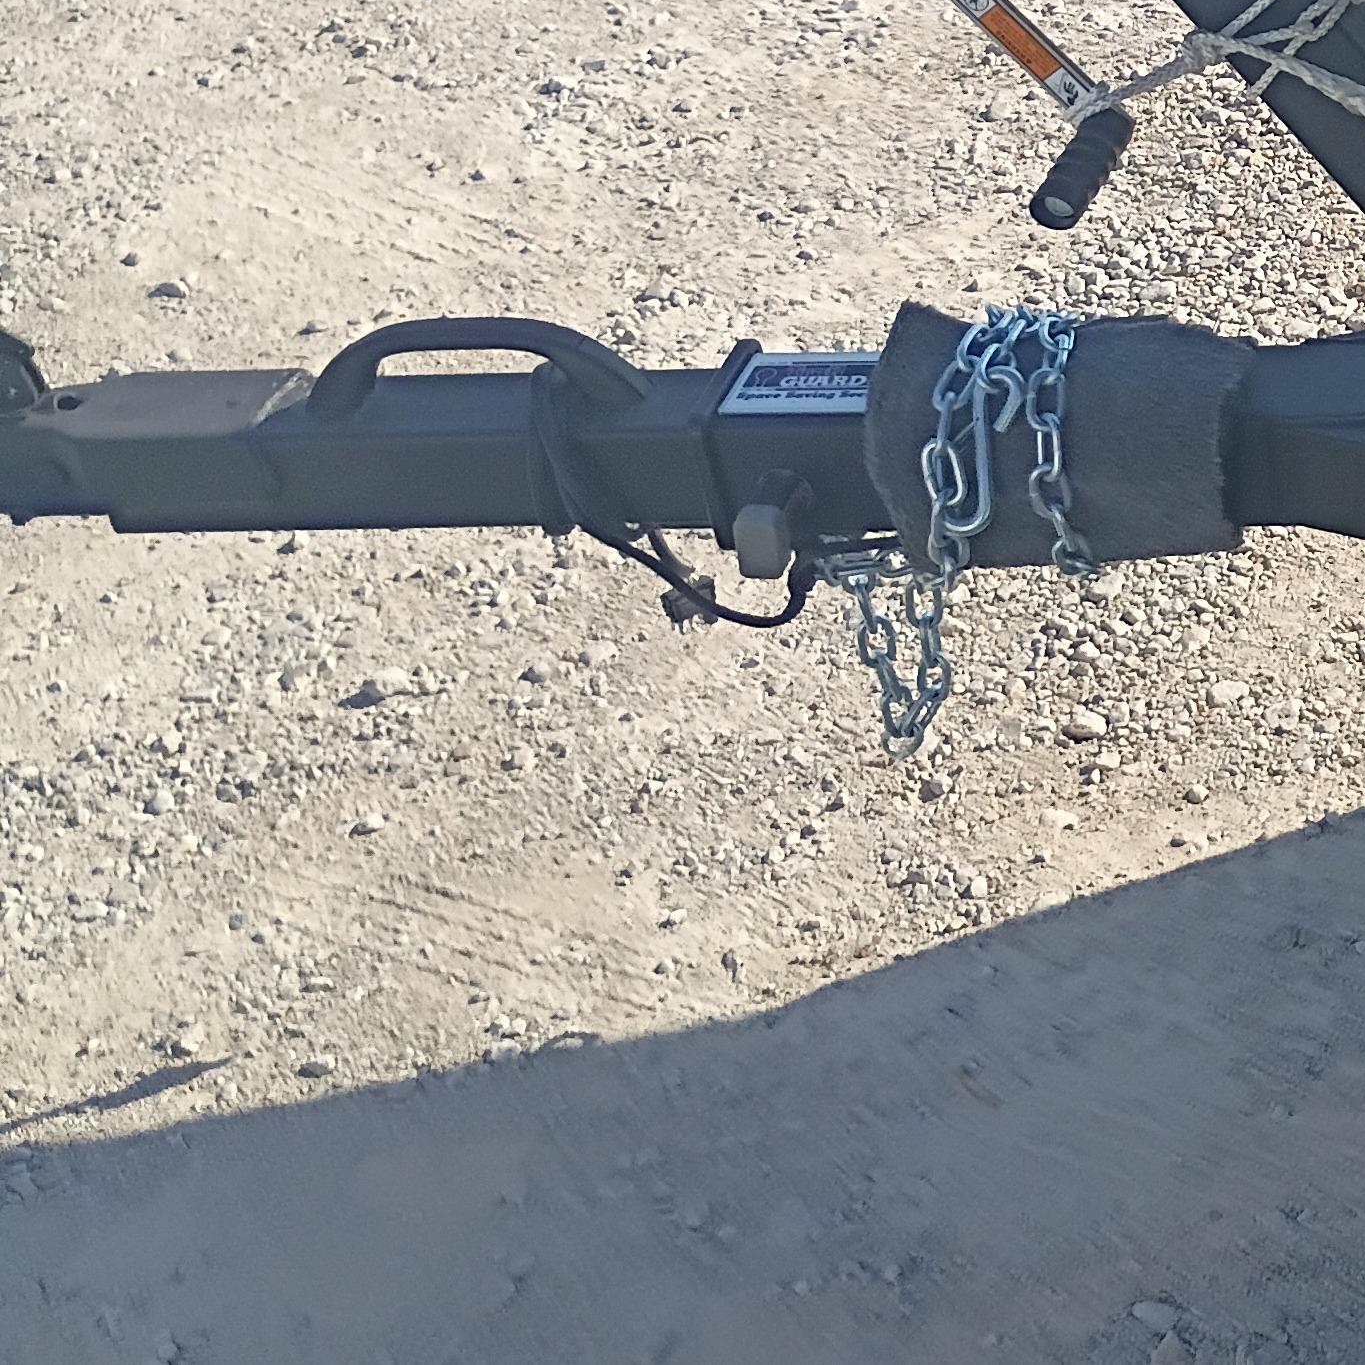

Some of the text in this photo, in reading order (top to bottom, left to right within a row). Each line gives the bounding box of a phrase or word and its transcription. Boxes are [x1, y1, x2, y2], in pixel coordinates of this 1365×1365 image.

[780, 375, 868, 387] GUARD
[735, 392, 782, 401] Space
[785, 391, 836, 400] Saving
